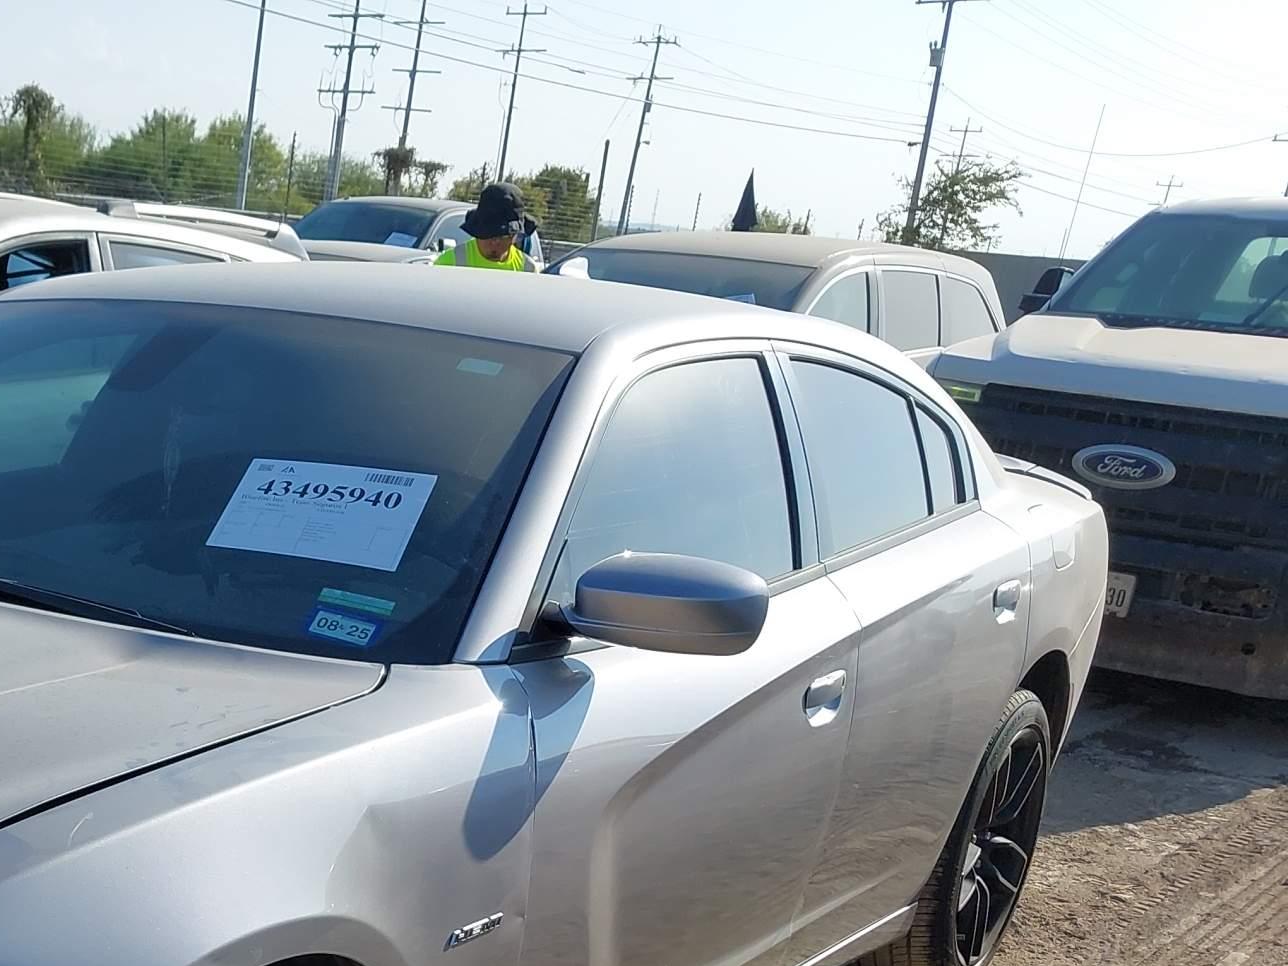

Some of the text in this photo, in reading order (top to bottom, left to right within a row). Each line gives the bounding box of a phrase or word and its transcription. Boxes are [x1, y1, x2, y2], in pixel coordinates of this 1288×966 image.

[1097, 455, 1147, 479] Ford
[256, 479, 402, 510] 43495940
[316, 617, 370, 640] 08 25
